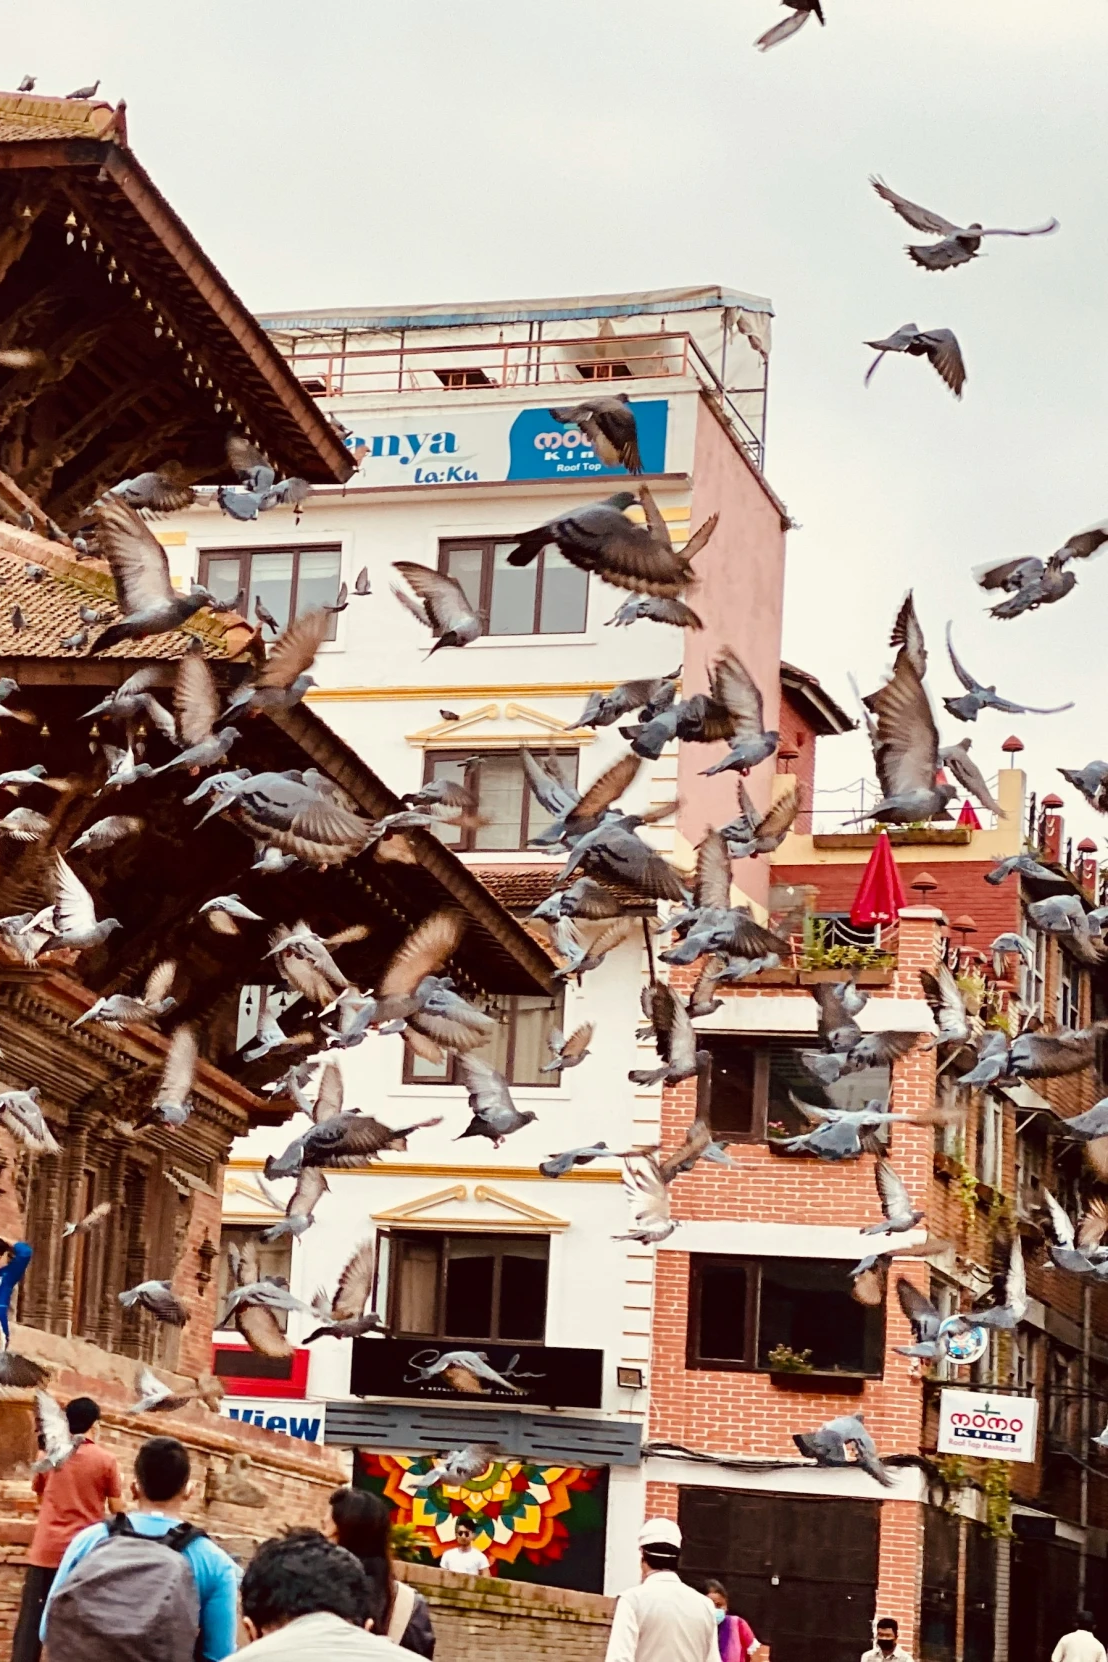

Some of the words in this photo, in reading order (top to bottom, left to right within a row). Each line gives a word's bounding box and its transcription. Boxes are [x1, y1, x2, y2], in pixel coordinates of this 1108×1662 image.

[544, 451, 594, 460] Kin
[556, 463, 581, 472] Roof
[582, 462, 602, 472] Top
[948, 1438, 966, 1446] Roof
[967, 1440, 981, 1449] Top
[983, 1442, 1021, 1452] Restaurant
